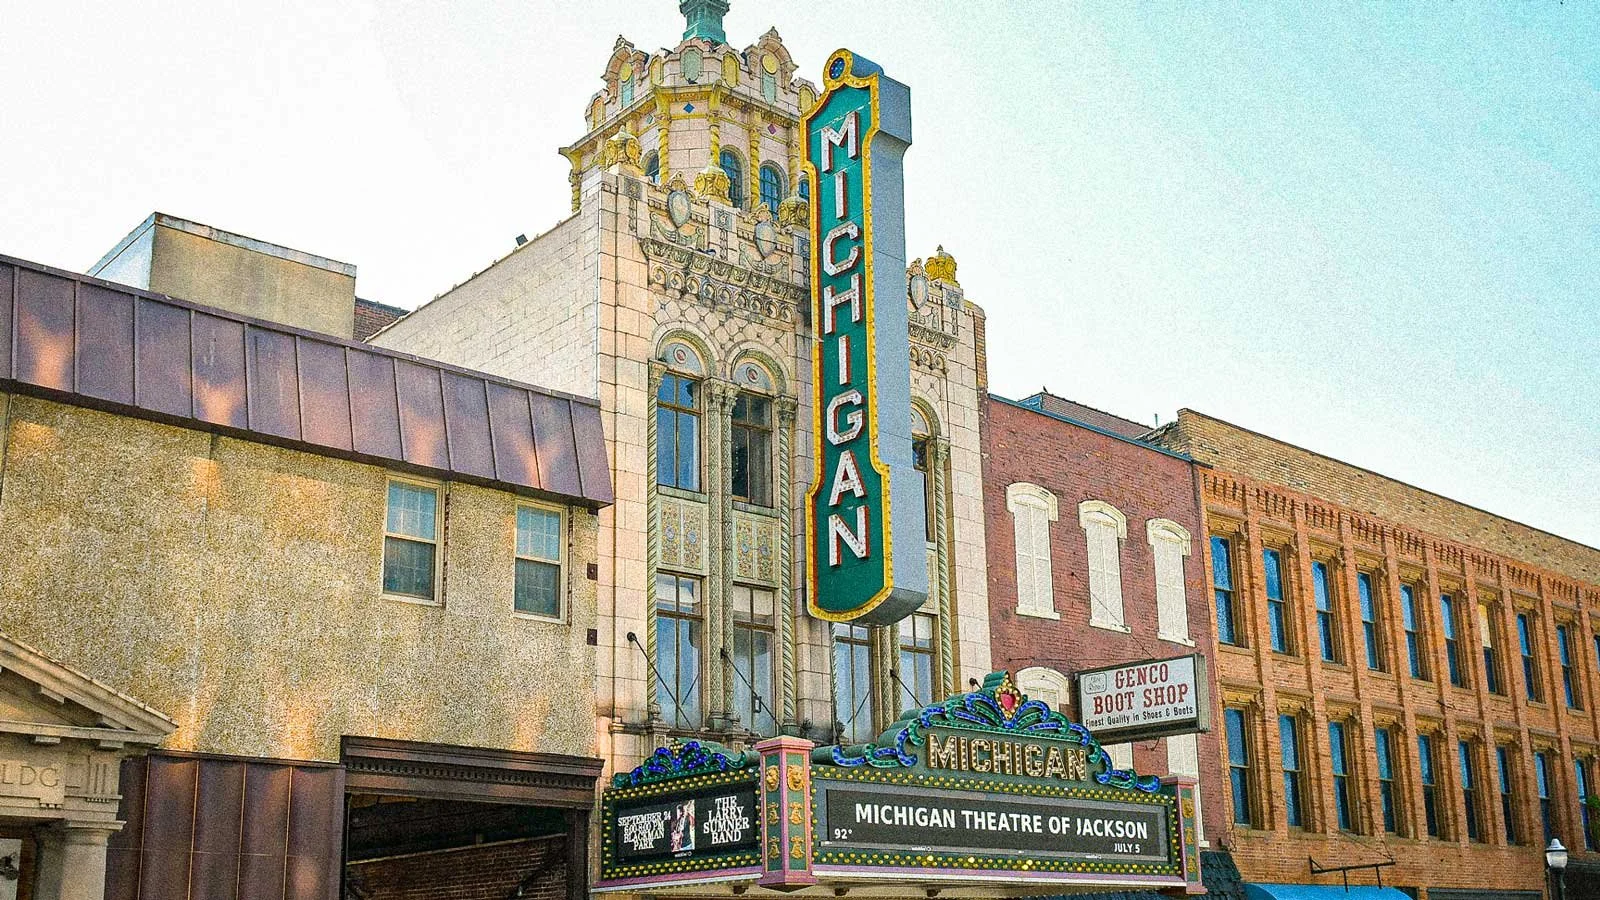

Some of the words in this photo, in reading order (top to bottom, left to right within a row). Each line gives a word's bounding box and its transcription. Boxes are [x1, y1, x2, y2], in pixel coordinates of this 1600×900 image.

[820, 110, 870, 567] MICHIGAN
[1115, 663, 1169, 689] GENCO
[1093, 691, 1135, 715] BOOT
[1143, 683, 1188, 708] SHOP
[1085, 717, 1105, 728] Finest
[1107, 713, 1131, 726] Quality
[1142, 708, 1162, 720] Shoes
[1165, 707, 1171, 717] &
[1173, 705, 1194, 716] Boots
[927, 733, 1088, 782] MICHIGAN
[715, 795, 737, 810] THE
[617, 812, 662, 827] SEPTEMBER
[708, 805, 744, 822] LARRY
[855, 803, 956, 829] MICHIGAN
[960, 810, 1043, 833] THEATRE
[1048, 815, 1070, 835] OF
[1076, 817, 1148, 840] JACKSON
[653, 819, 664, 832] PM
[703, 817, 750, 834] SUMNER
[623, 828, 664, 844] BLACKMAN
[633, 838, 655, 851] PARK
[711, 830, 742, 845] BAND
[1114, 843, 1133, 854] JULY
[1134, 843, 1141, 854] 5
